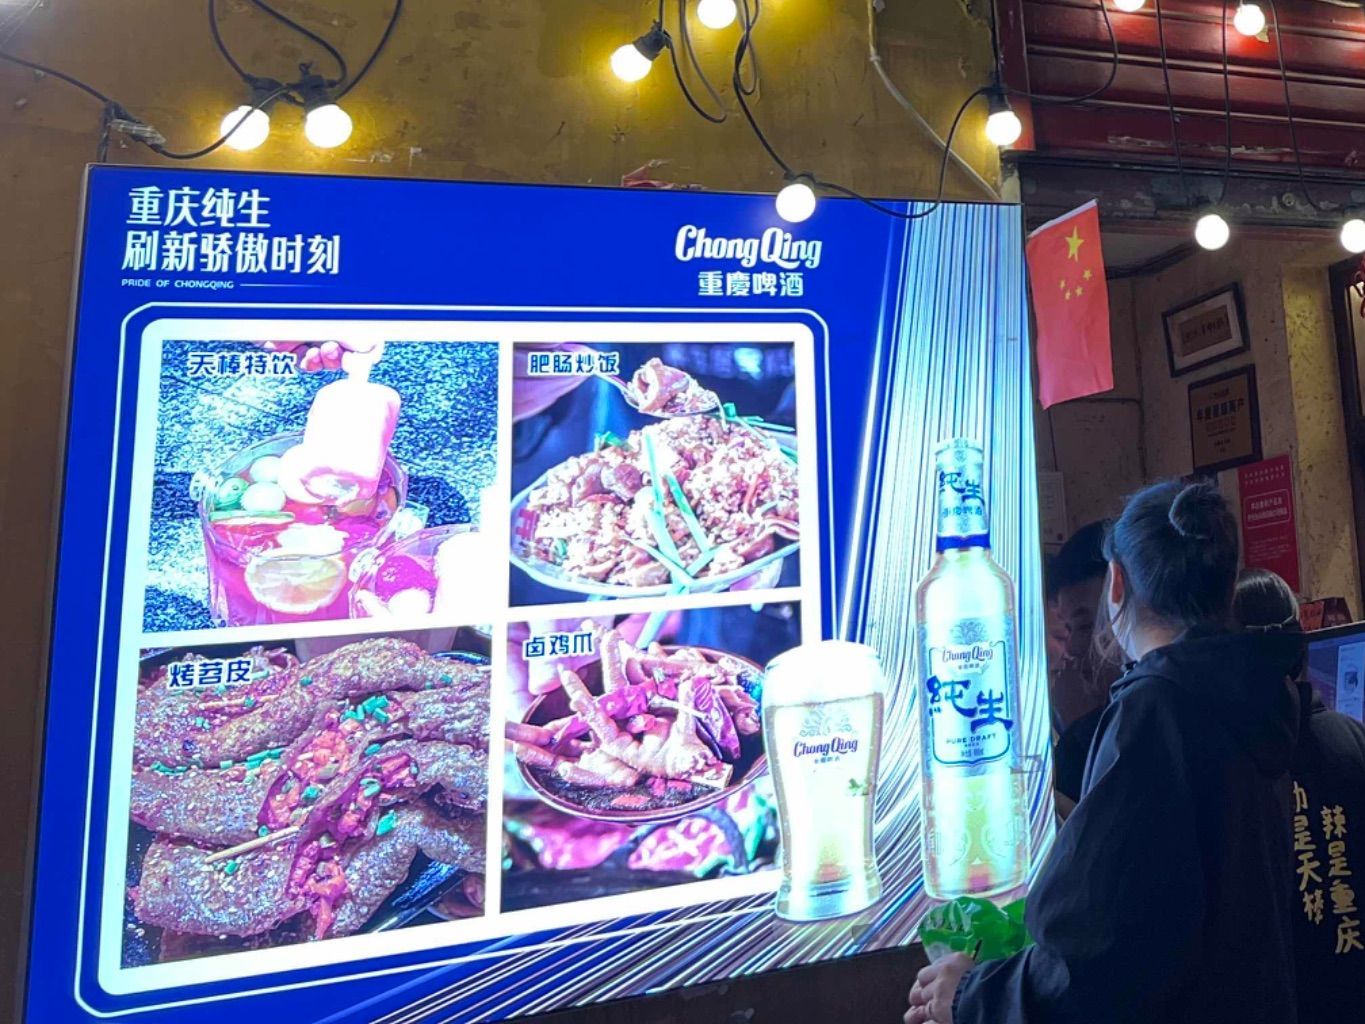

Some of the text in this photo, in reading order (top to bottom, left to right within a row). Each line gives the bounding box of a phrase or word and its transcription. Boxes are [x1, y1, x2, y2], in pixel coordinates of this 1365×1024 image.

[125, 185, 272, 229] 重庆纯生
[121, 230, 340, 275] 刷新骄傲时刻
[121, 278, 235, 290] PRIDE OF CHONGQING
[697, 271, 804, 297] 重慶啤酒
[187, 351, 295, 378] 天棒特饮
[526, 351, 620, 377] 肥肠炒饭
[522, 631, 595, 659] 卤鸡爪
[169, 658, 252, 688] 烤苕皮
[946, 734, 997, 745] PURE DRAFT
[1319, 803, 1365, 955] 辣是重庆
